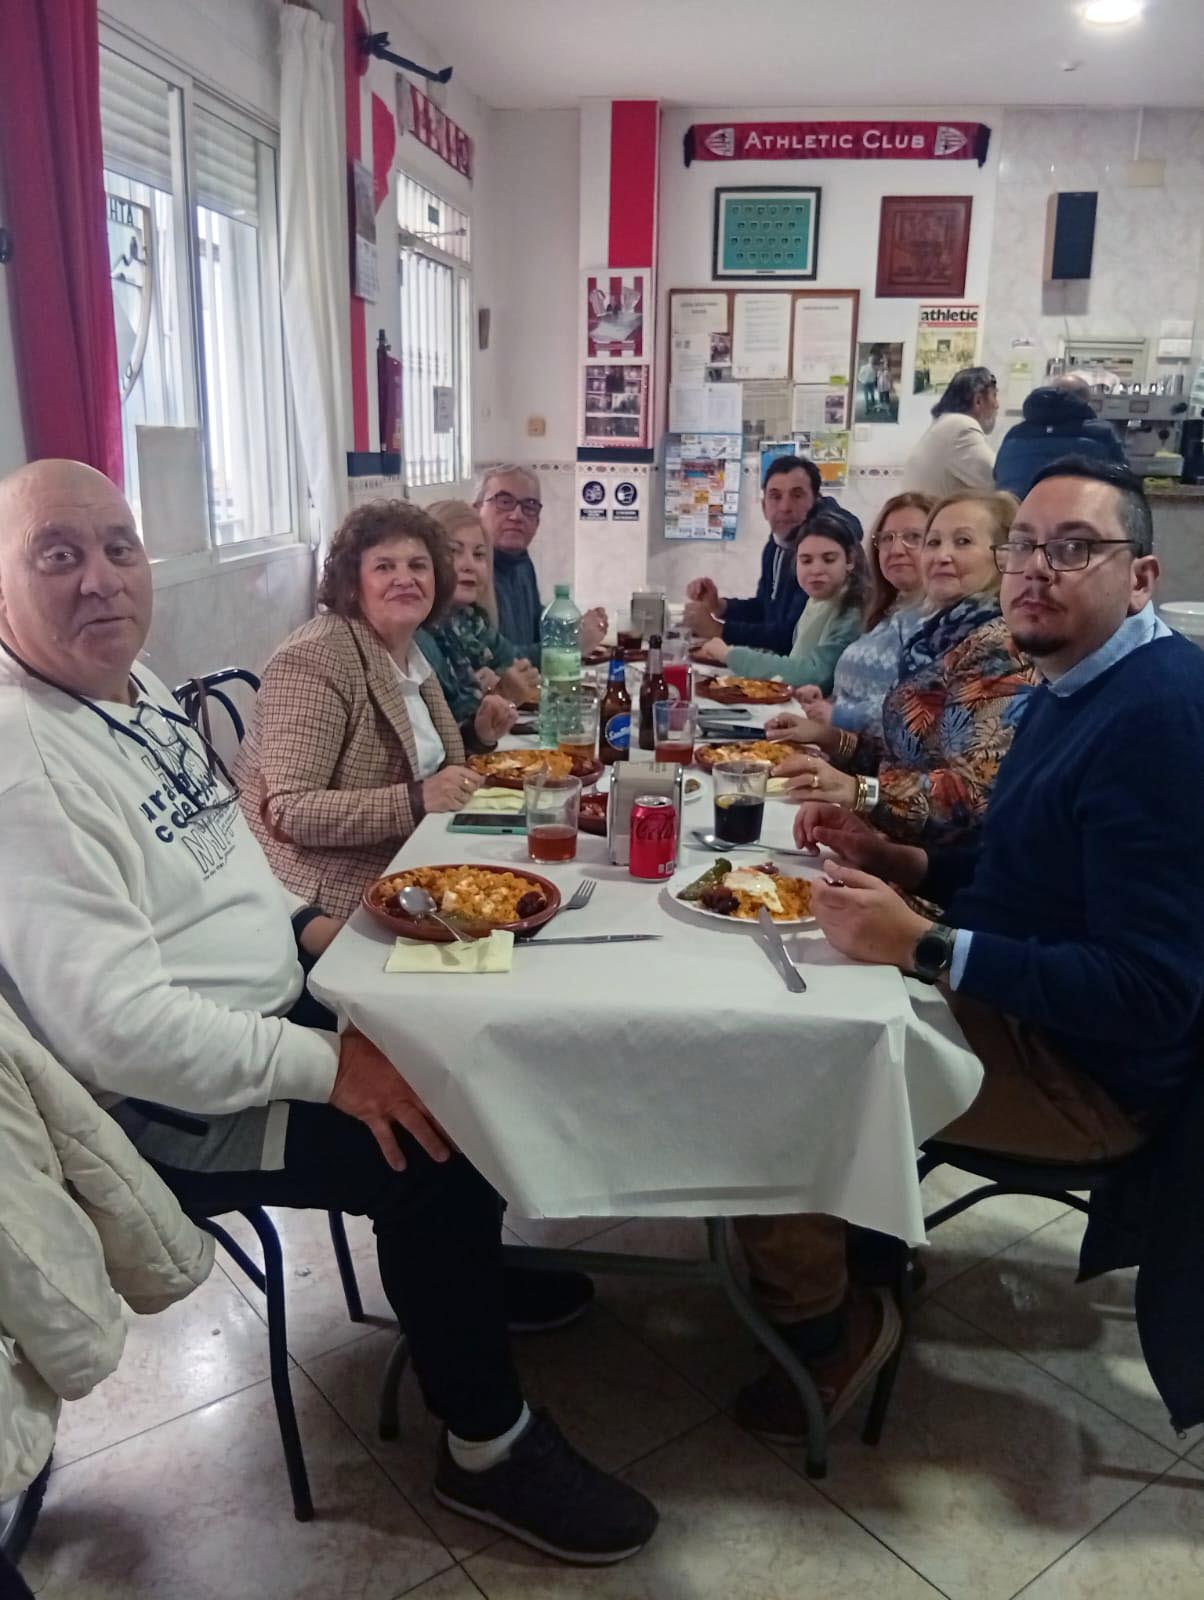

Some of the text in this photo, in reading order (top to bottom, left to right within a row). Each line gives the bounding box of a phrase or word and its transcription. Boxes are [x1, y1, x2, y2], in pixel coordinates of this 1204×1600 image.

[744, 130, 925, 149] ATHLETIC CLUB
[920, 308, 978, 322] athletic
